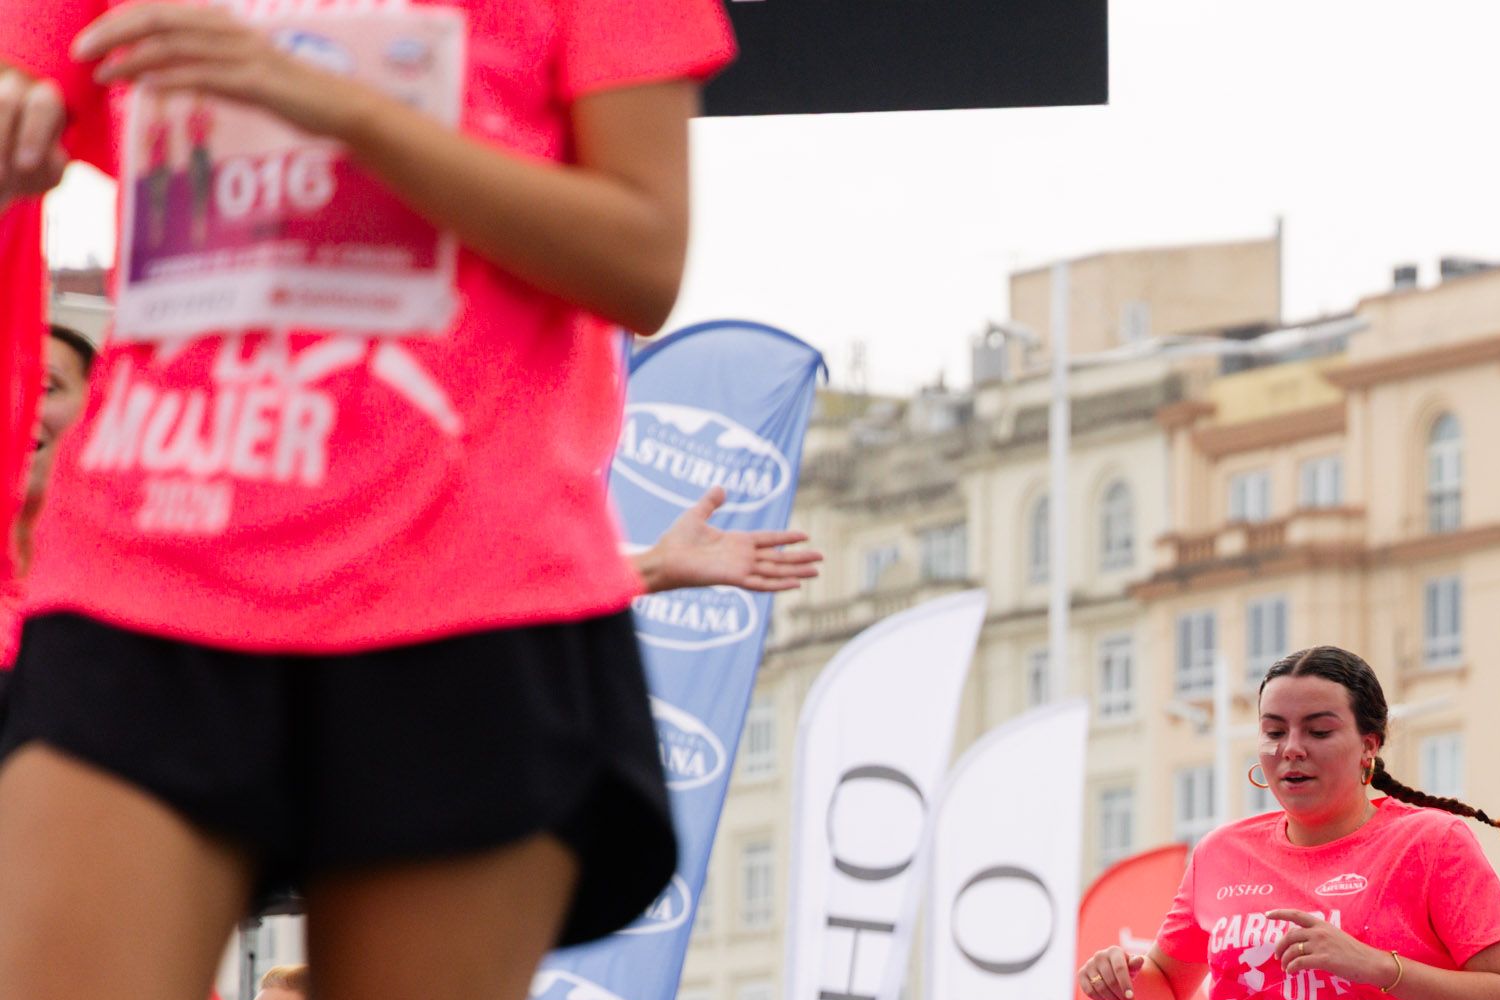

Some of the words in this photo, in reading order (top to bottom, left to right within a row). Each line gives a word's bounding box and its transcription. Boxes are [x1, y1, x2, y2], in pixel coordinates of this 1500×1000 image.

[215, 146, 337, 221] 016
[80, 352, 338, 488] MUJER
[1216, 883, 1274, 900] OYSHO
